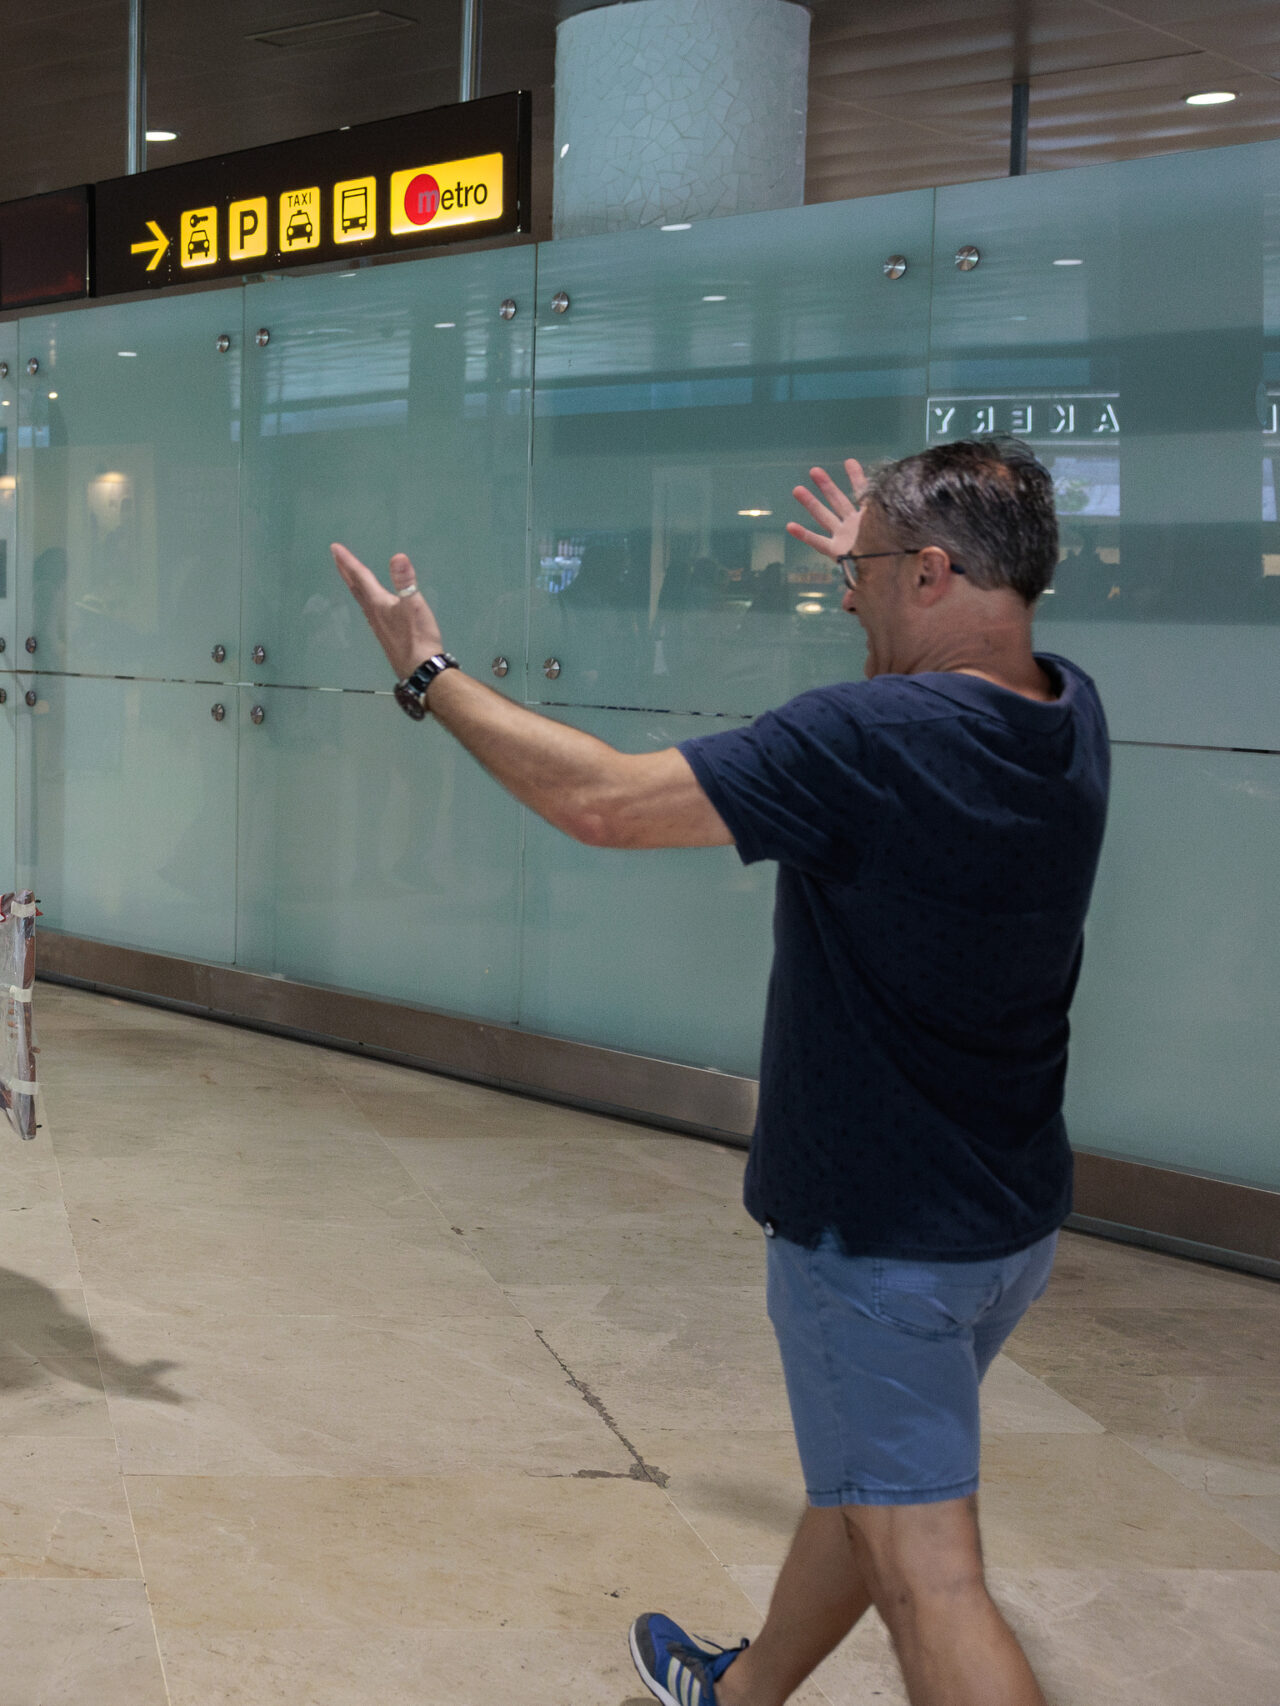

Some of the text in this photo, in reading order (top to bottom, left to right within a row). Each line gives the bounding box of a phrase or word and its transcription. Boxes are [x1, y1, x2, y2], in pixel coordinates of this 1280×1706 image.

[287, 191, 312, 207] TAXI
[417, 182, 488, 214] metro
[239, 209, 258, 250] P
